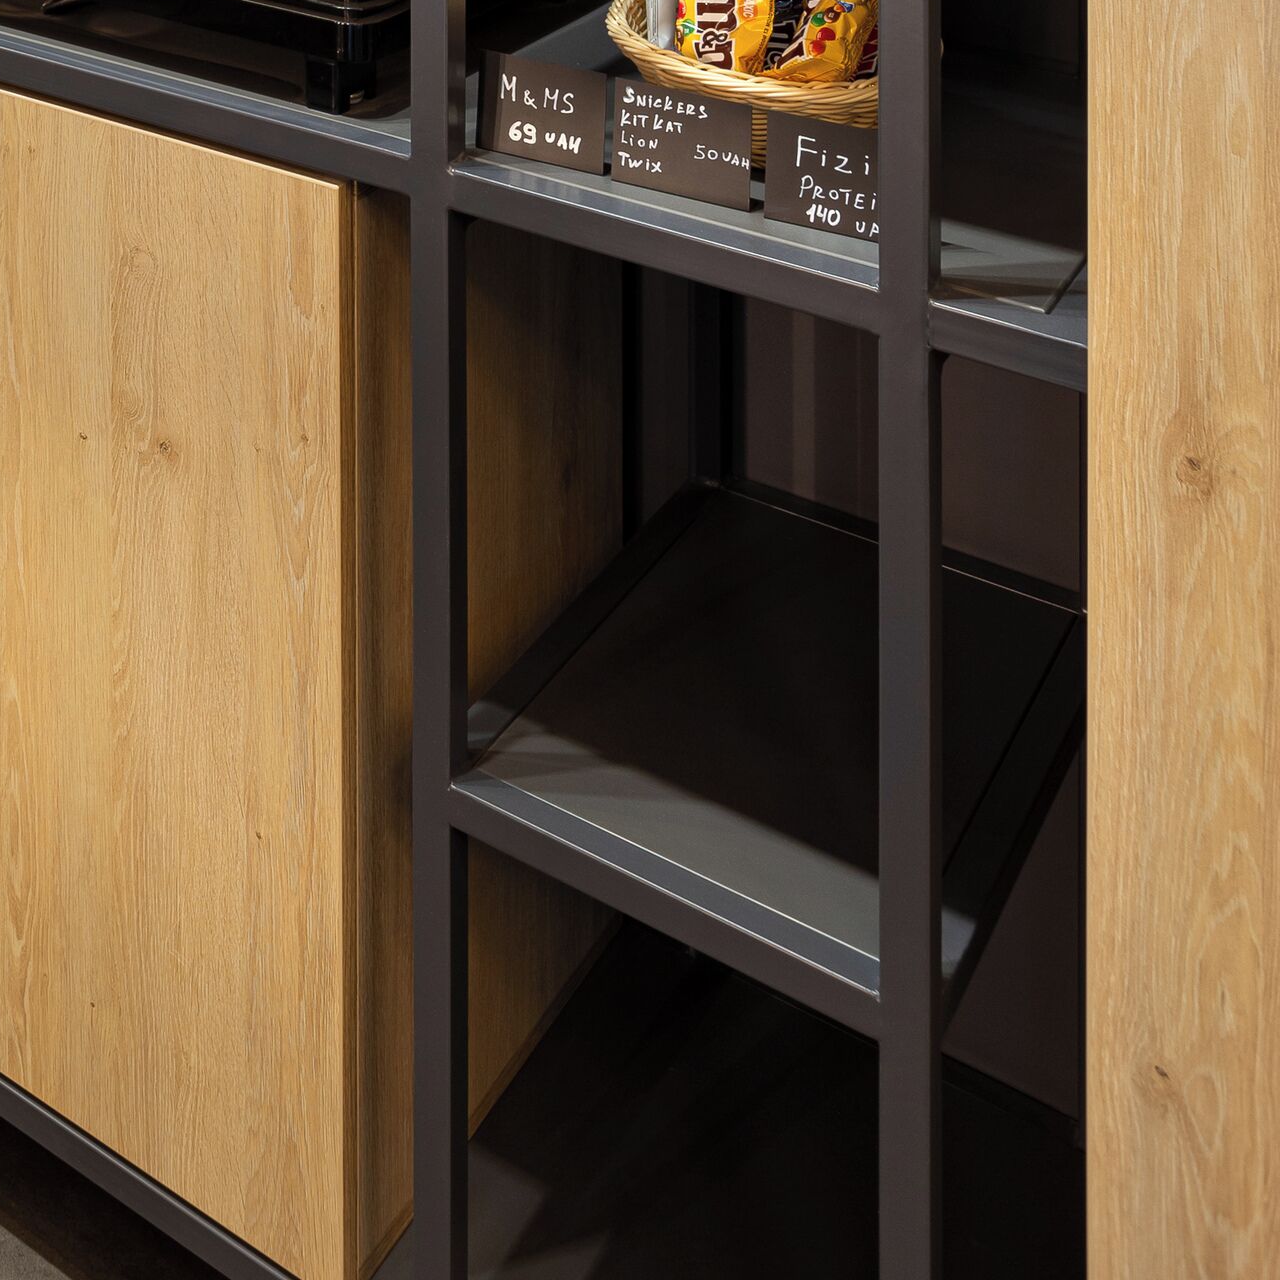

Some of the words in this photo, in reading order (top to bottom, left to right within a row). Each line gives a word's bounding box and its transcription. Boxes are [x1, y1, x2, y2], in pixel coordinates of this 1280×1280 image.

[622, 86, 708, 119] SNICKERS
[508, 121, 537, 144] 69
[545, 132, 582, 154] UAH
[694, 143, 718, 160] 50
[722, 151, 750, 170] UAH
[806, 203, 841, 226] 140
